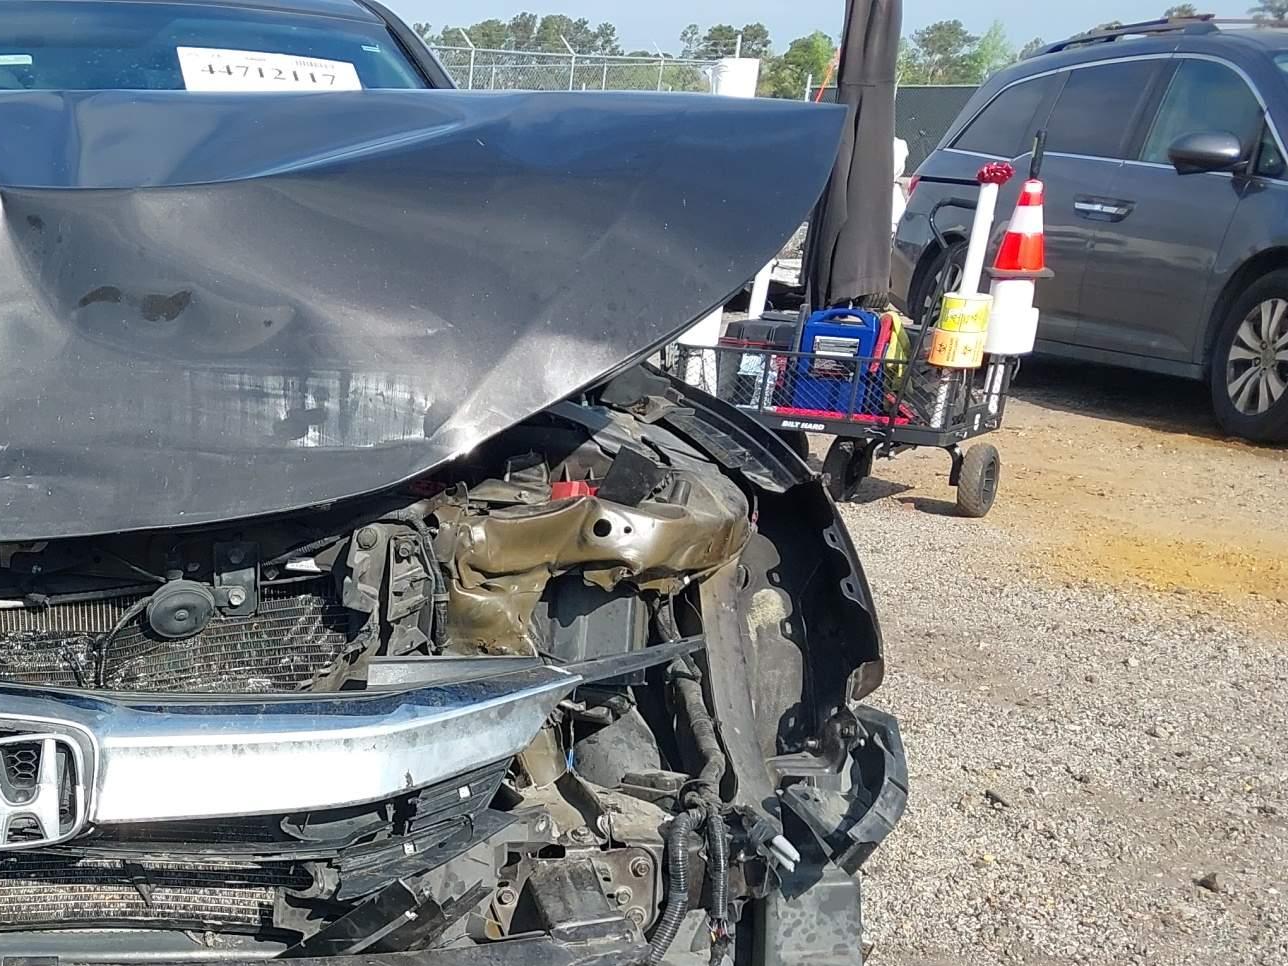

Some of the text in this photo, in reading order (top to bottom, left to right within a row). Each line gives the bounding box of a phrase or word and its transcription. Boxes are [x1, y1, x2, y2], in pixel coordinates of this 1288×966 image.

[200, 63, 337, 86] 44712117
[781, 420, 825, 431] BILT HARD
